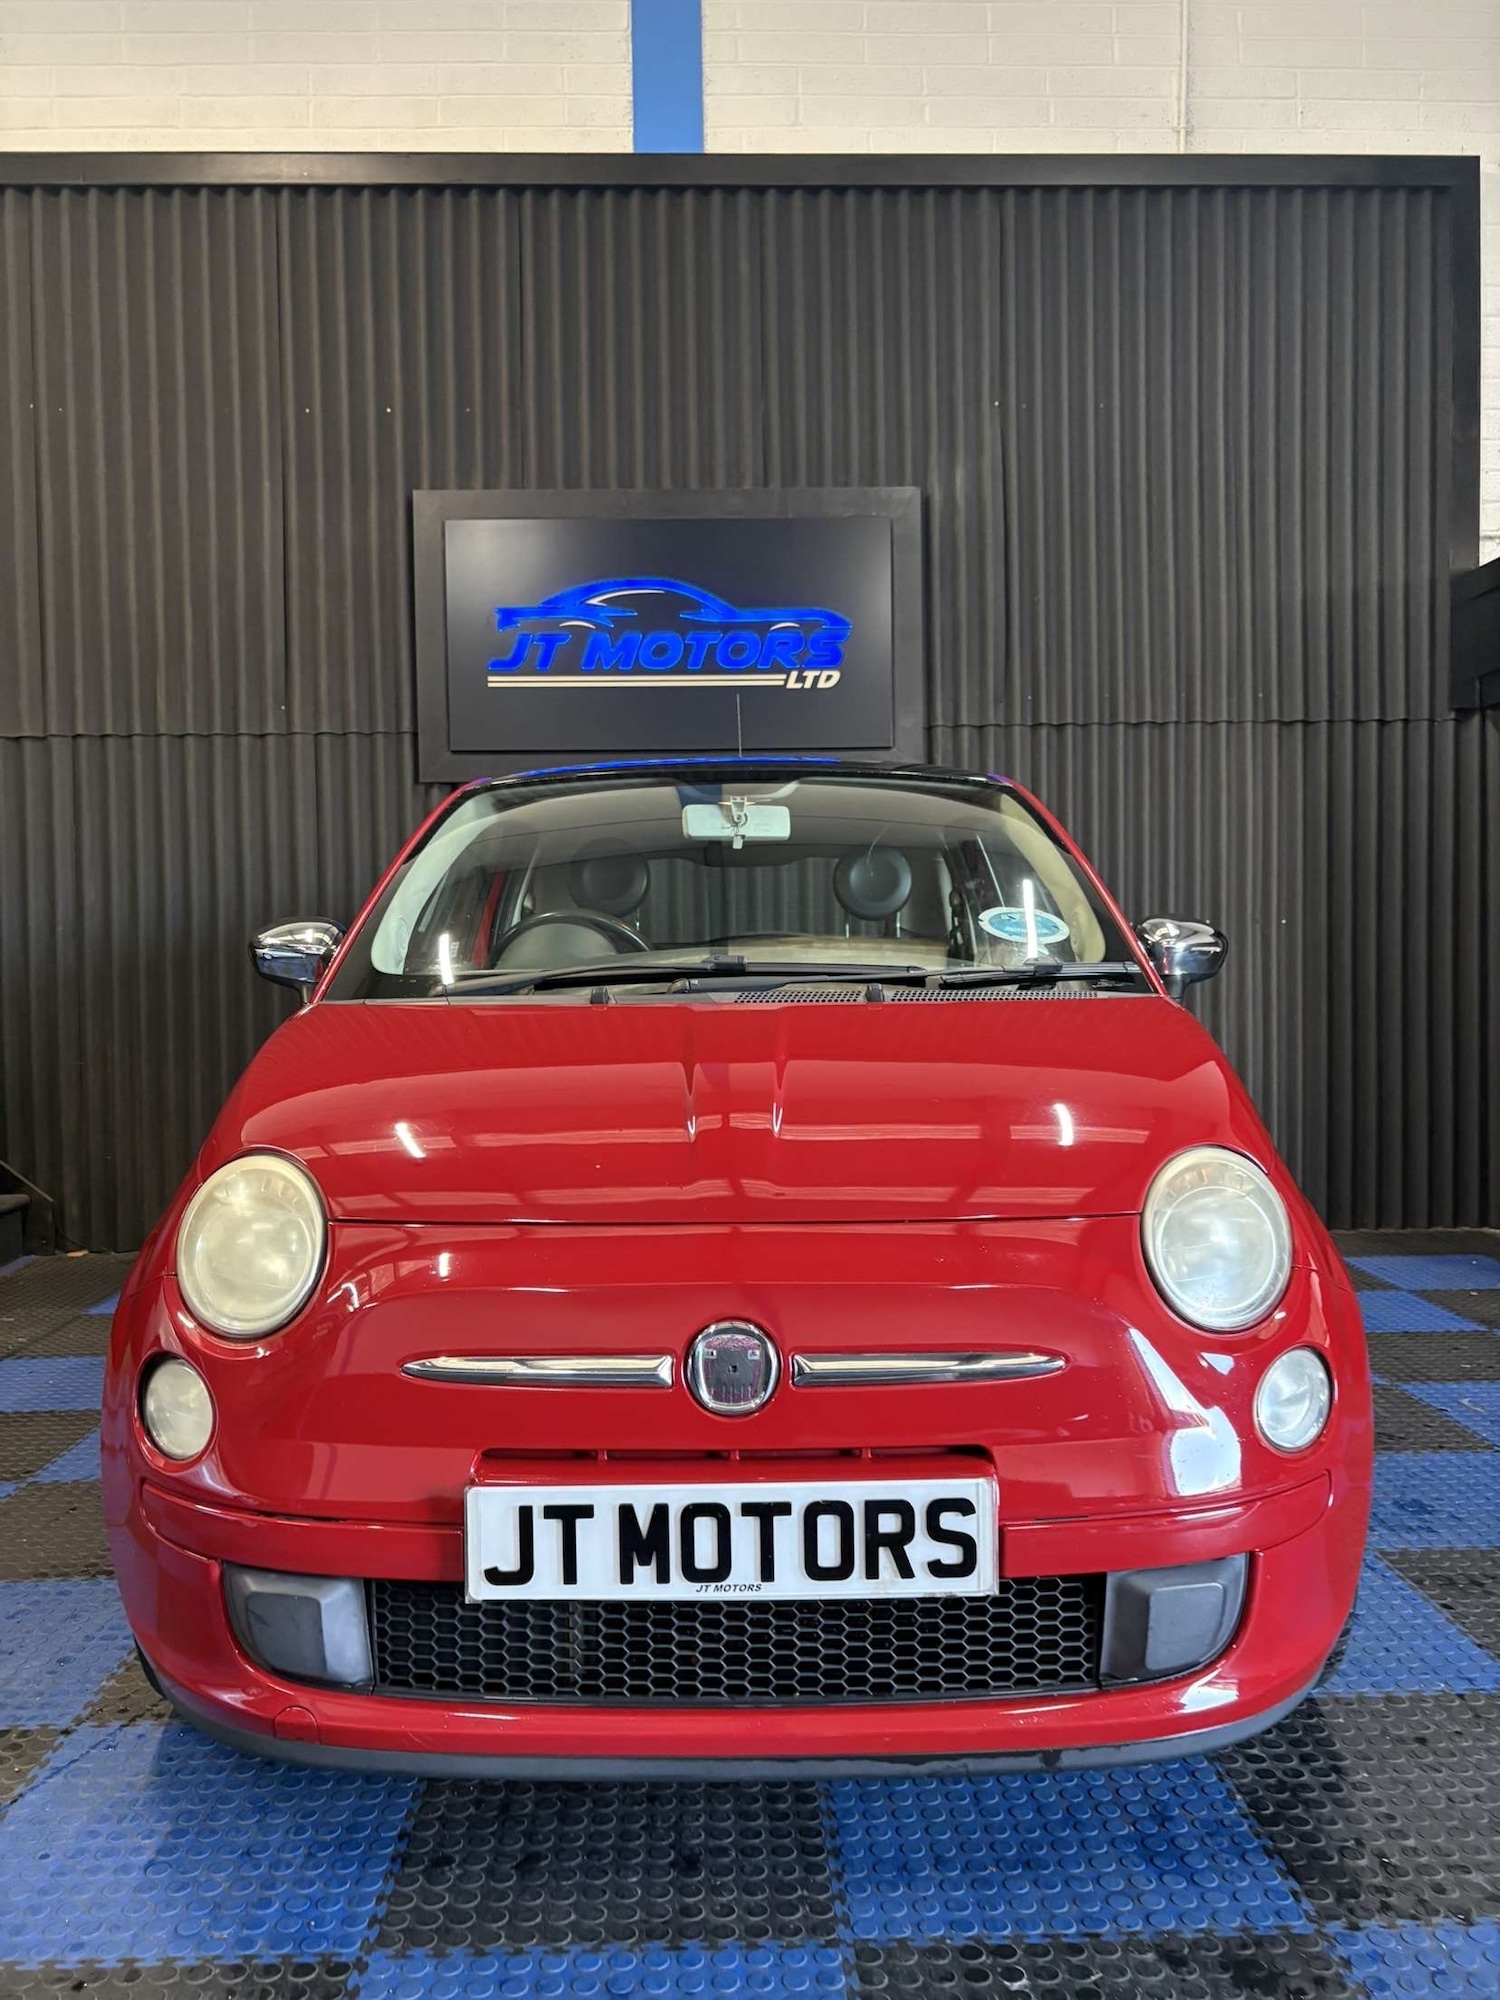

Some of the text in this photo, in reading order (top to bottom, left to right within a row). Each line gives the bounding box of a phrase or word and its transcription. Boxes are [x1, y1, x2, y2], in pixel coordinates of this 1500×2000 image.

[487, 631, 852, 671] JT MOTORS
[785, 670, 842, 690] LTD
[484, 1498, 978, 1585] JT MOTORS
[696, 1583, 762, 1592] JT MOTORS
